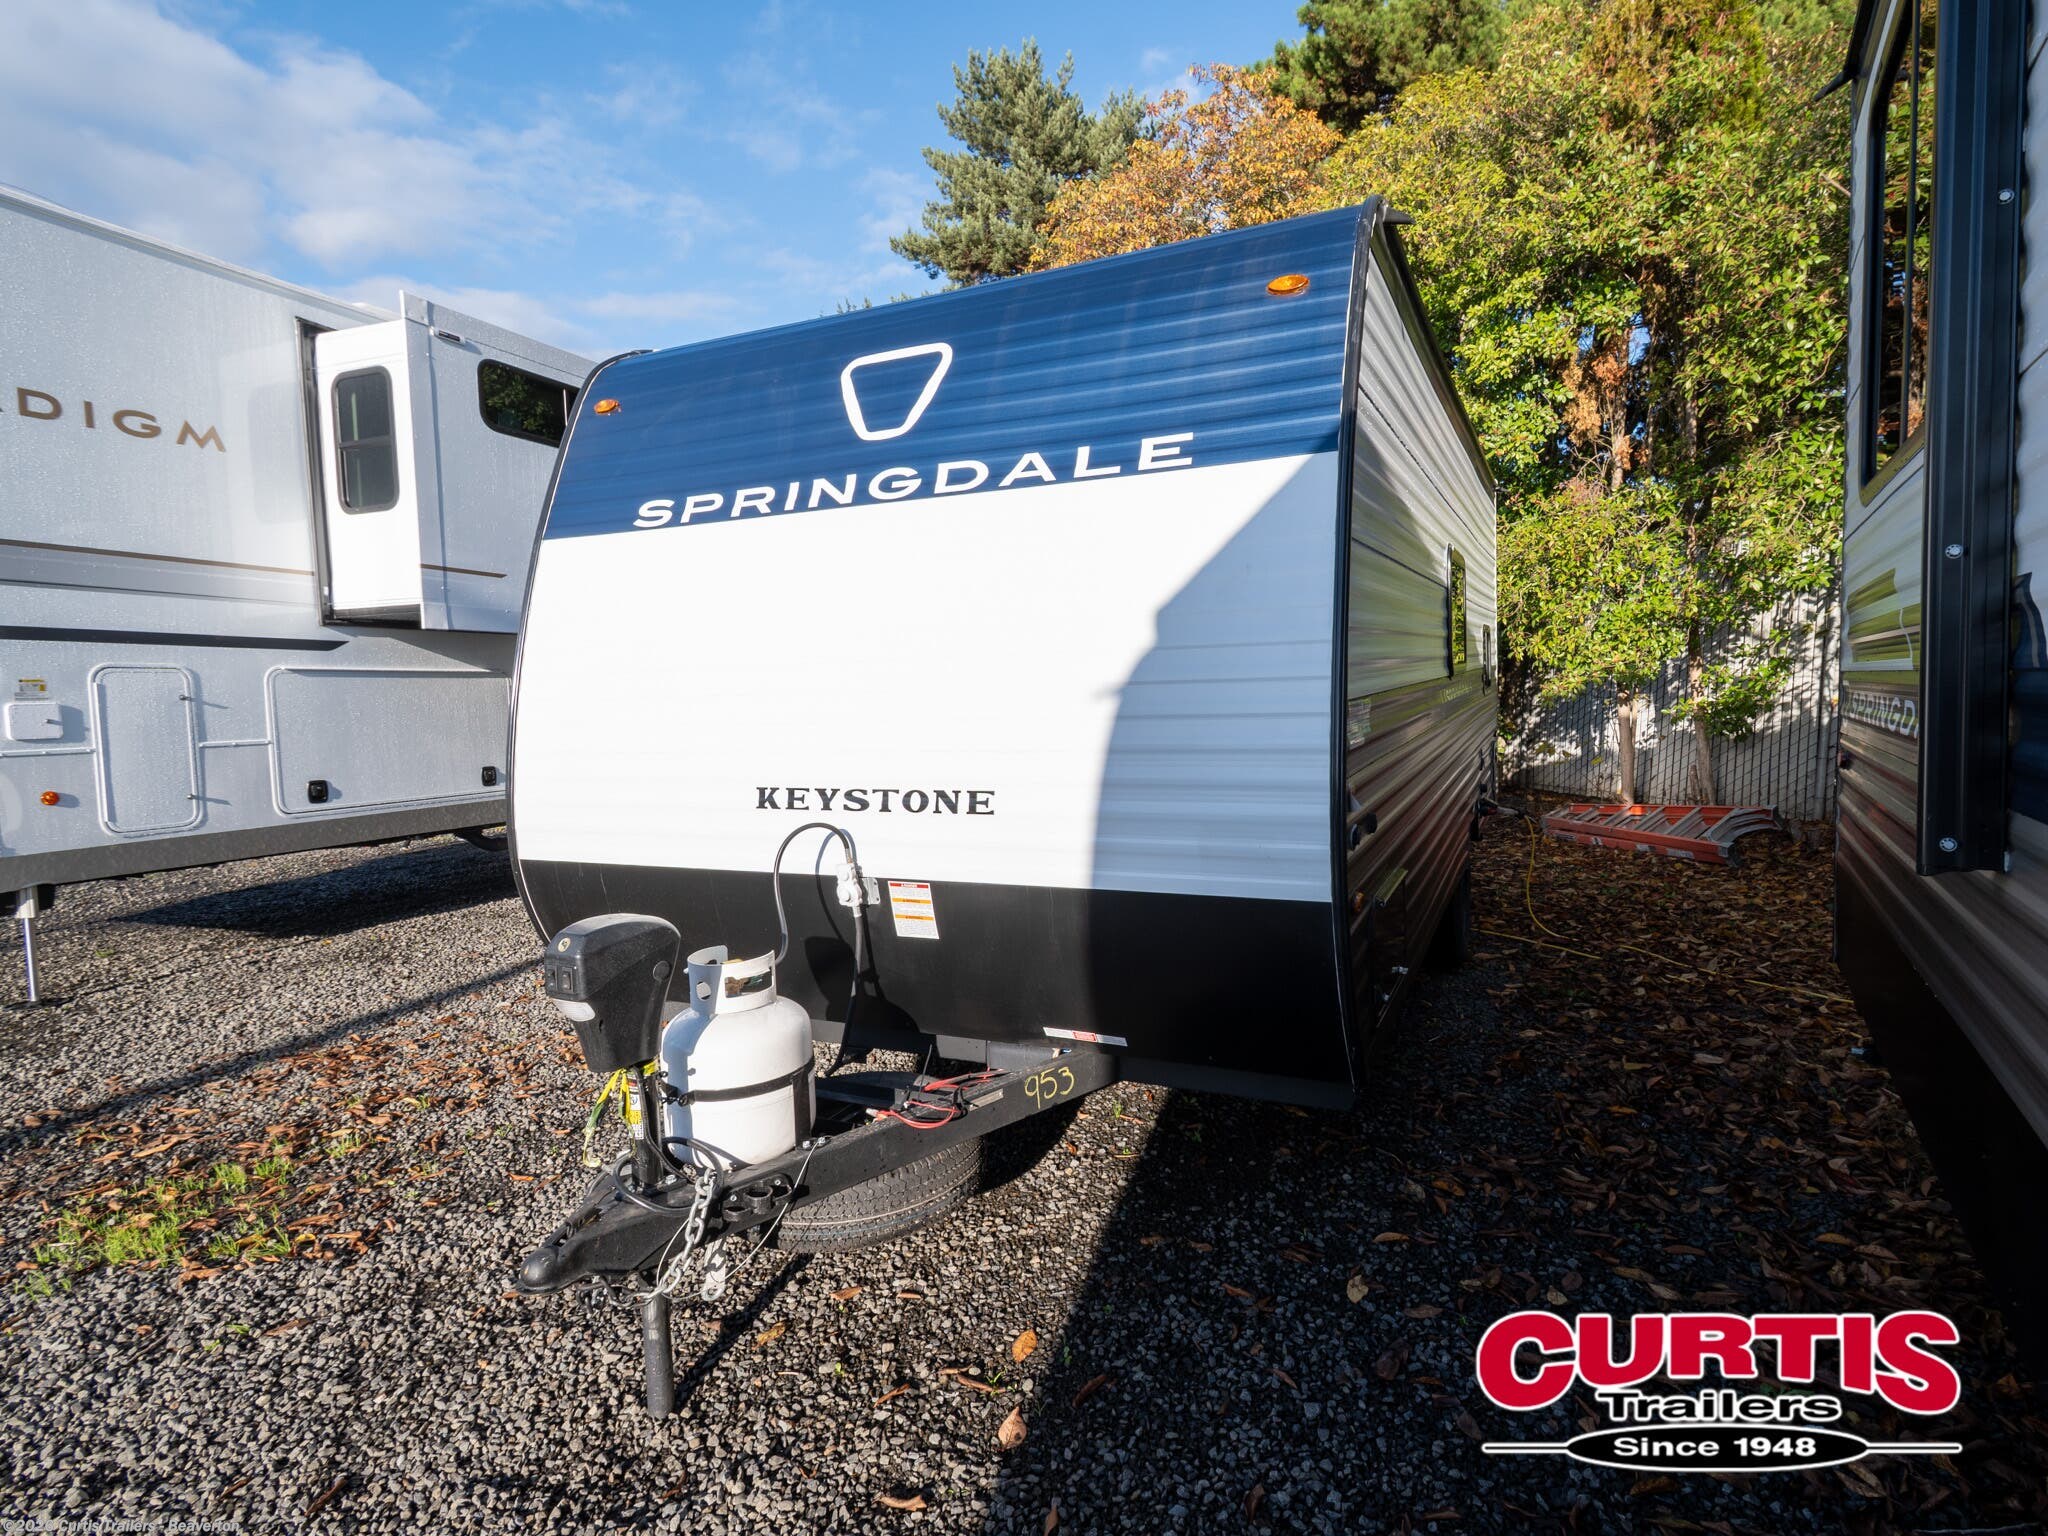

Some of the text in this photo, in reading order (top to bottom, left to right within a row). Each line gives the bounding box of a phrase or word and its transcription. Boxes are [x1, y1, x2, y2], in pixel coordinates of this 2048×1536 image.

[0, 387, 227, 452] DIGM
[633, 431, 1195, 529] SPRINGDALE
[1849, 691, 1919, 739] SPRINGD
[756, 786, 996, 816] KEYSTONE
[1024, 1066, 1075, 1110] 953
